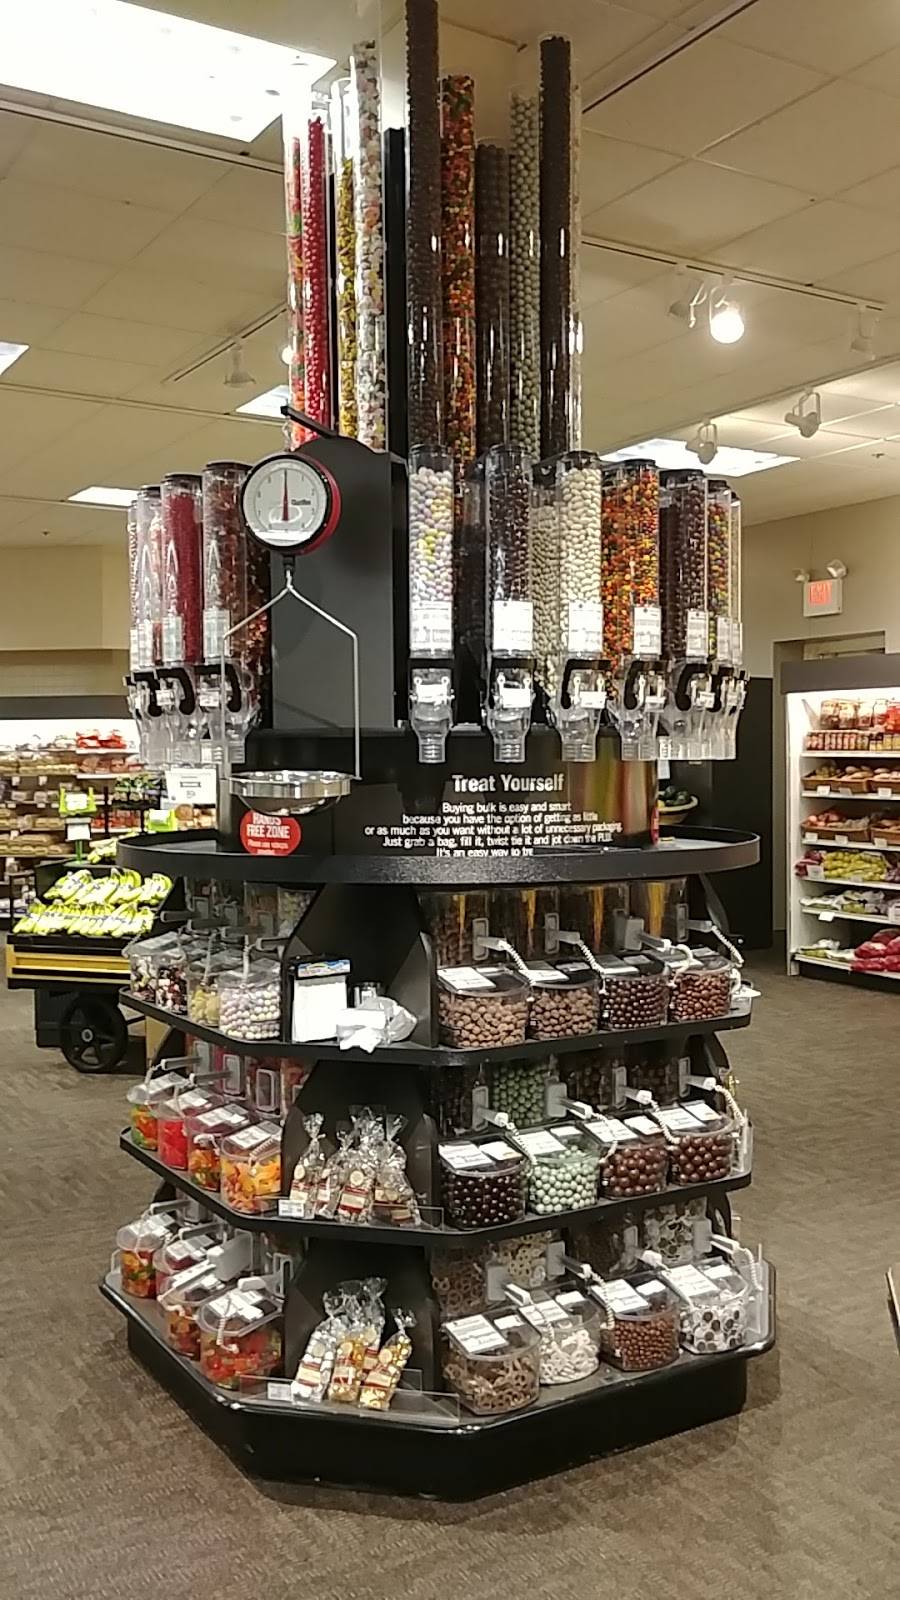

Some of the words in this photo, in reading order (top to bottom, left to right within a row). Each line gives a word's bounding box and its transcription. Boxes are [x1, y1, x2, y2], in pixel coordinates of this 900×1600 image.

[452, 774, 496, 793] Treat
[500, 773, 565, 792] Yourself
[442, 802, 475, 815] Buying
[476, 802, 497, 813] bulk
[499, 802, 507, 813] is
[509, 803, 529, 814] easy
[531, 802, 548, 812] and
[549, 802, 572, 812] smart
[402, 814, 441, 825] because
[443, 815, 461, 826] you
[462, 814, 485, 824] have
[486, 813, 503, 824] the
[504, 813, 532, 825] option
[533, 812, 543, 823] of
[544, 812, 571, 825] getting
[572, 813, 582, 823] as
[246, 823, 266, 837] FREE
[266, 825, 291, 839] ZONE
[364, 827, 376, 836] or
[376, 827, 389, 836] as
[390, 826, 417, 836] much
[419, 827, 430, 836] as
[432, 827, 451, 838] you
[452, 826, 475, 836] want
[476, 824, 511, 835] without
[512, 826, 519, 834] a
[521, 824, 533, 834] lot
[534, 823, 544, 834] of
[545, 823, 591, 835] unnecessary
[382, 836, 403, 847] Just
[404, 837, 426, 849] grab
[427, 839, 435, 847] a
[460, 836, 473, 847] fill
[474, 836, 485, 848] it,
[486, 836, 509, 847] twist
[510, 835, 523, 846] tie
[524, 834, 533, 846] it
[533, 834, 550, 845] and
[551, 834, 562, 847] jot
[436, 847, 451, 857] It's
[452, 849, 466, 857] an
[467, 848, 489, 857] easy
[490, 849, 509, 857] way
[510, 847, 521, 857] to
